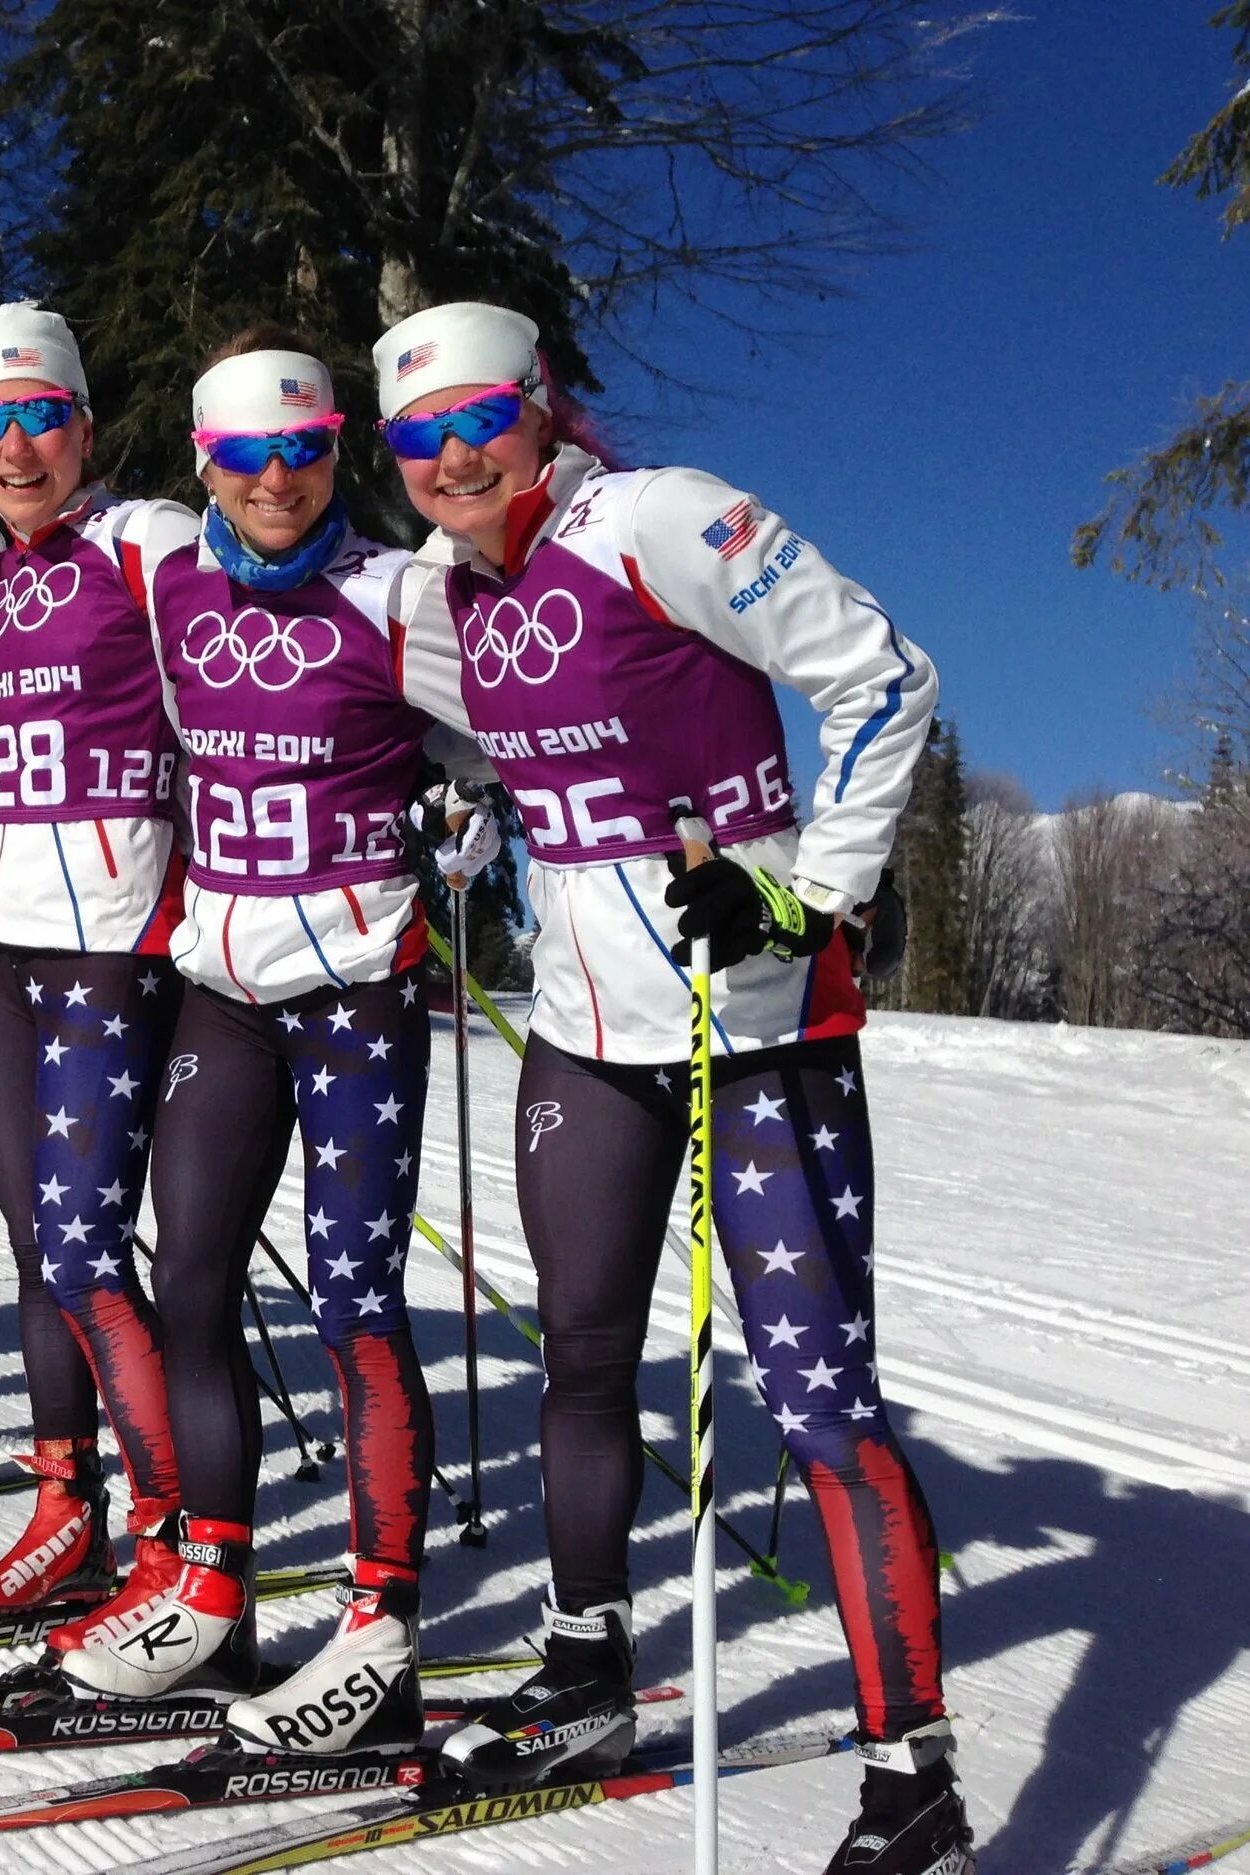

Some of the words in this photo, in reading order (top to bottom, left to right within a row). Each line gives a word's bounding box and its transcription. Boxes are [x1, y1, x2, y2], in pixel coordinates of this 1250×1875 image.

[729, 564, 781, 614] SOCHI
[774, 533, 806, 571] 2014
[19, 665, 82, 695] 2014
[254, 732, 335, 764] 2014
[536, 716, 630, 756] 2014
[86, 748, 176, 800] 128
[188, 774, 311, 876] 129
[512, 776, 647, 849] 26
[179, 1545, 222, 1565] OSSIG
[554, 1619, 607, 1633] SALOMON
[52, 1710, 225, 1737] ROSSIGNOL
[264, 1662, 390, 1749] ROSSI
[516, 1711, 612, 1757] SALOMON
[225, 1766, 395, 1800] ROSSIGNOL
[413, 1783, 599, 1837] SALOMON
